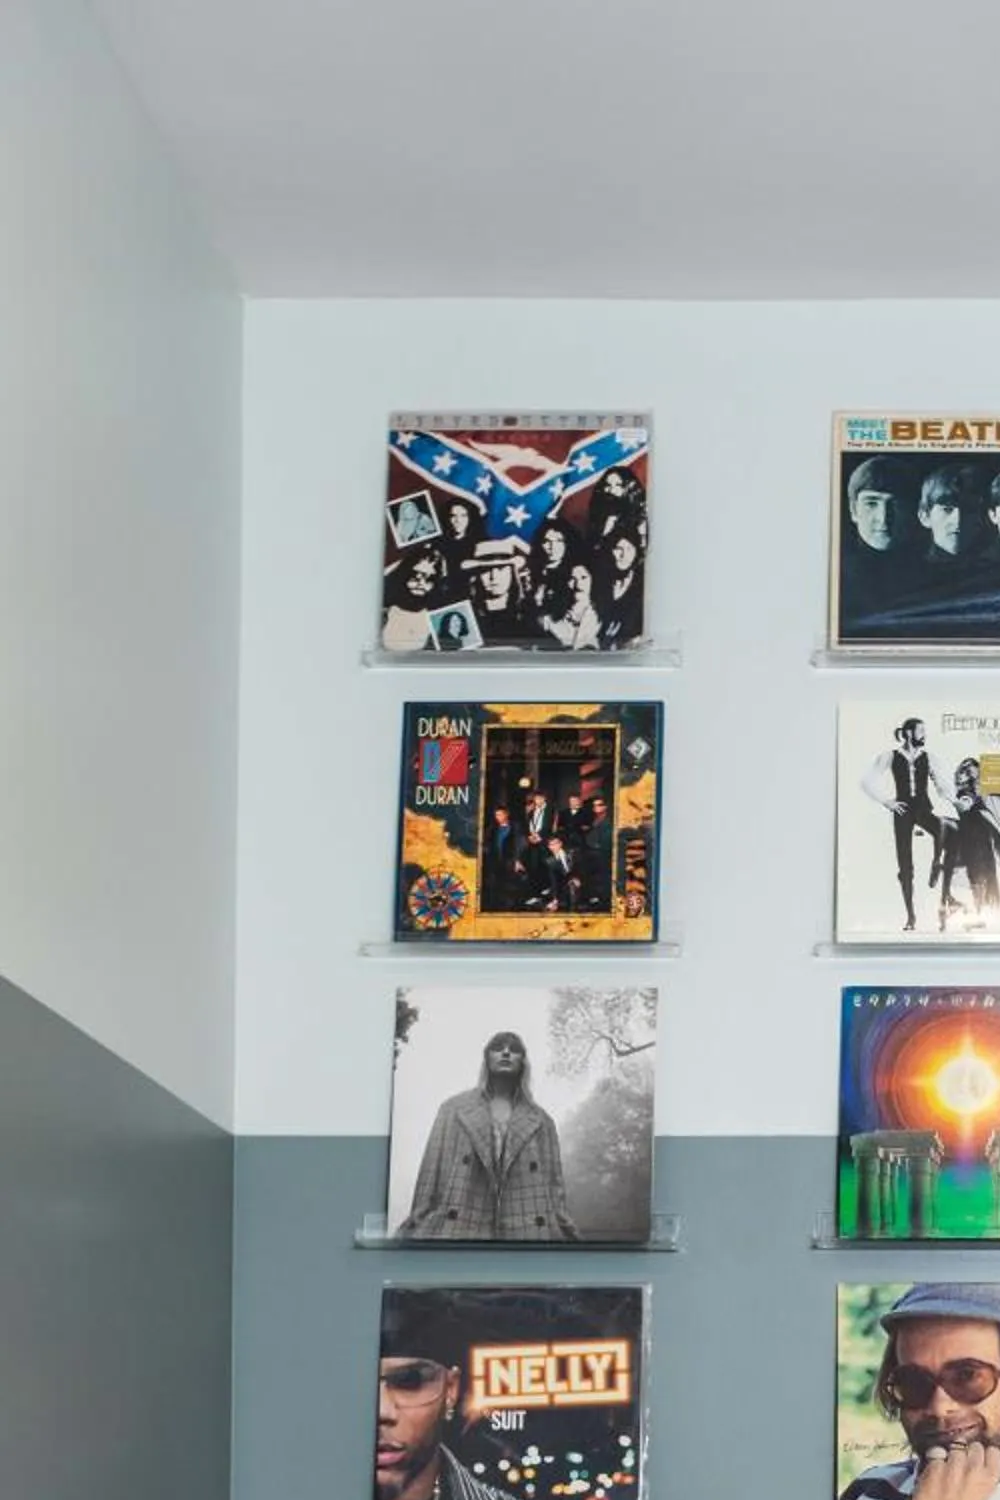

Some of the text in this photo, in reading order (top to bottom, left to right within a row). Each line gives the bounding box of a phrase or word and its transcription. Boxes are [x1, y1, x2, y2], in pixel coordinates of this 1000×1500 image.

[847, 430, 887, 441] THE
[418, 717, 472, 738] DURAN
[415, 785, 469, 806] DURAN
[490, 1354, 612, 1396] NELLY
[491, 1410, 527, 1431] SUIT
